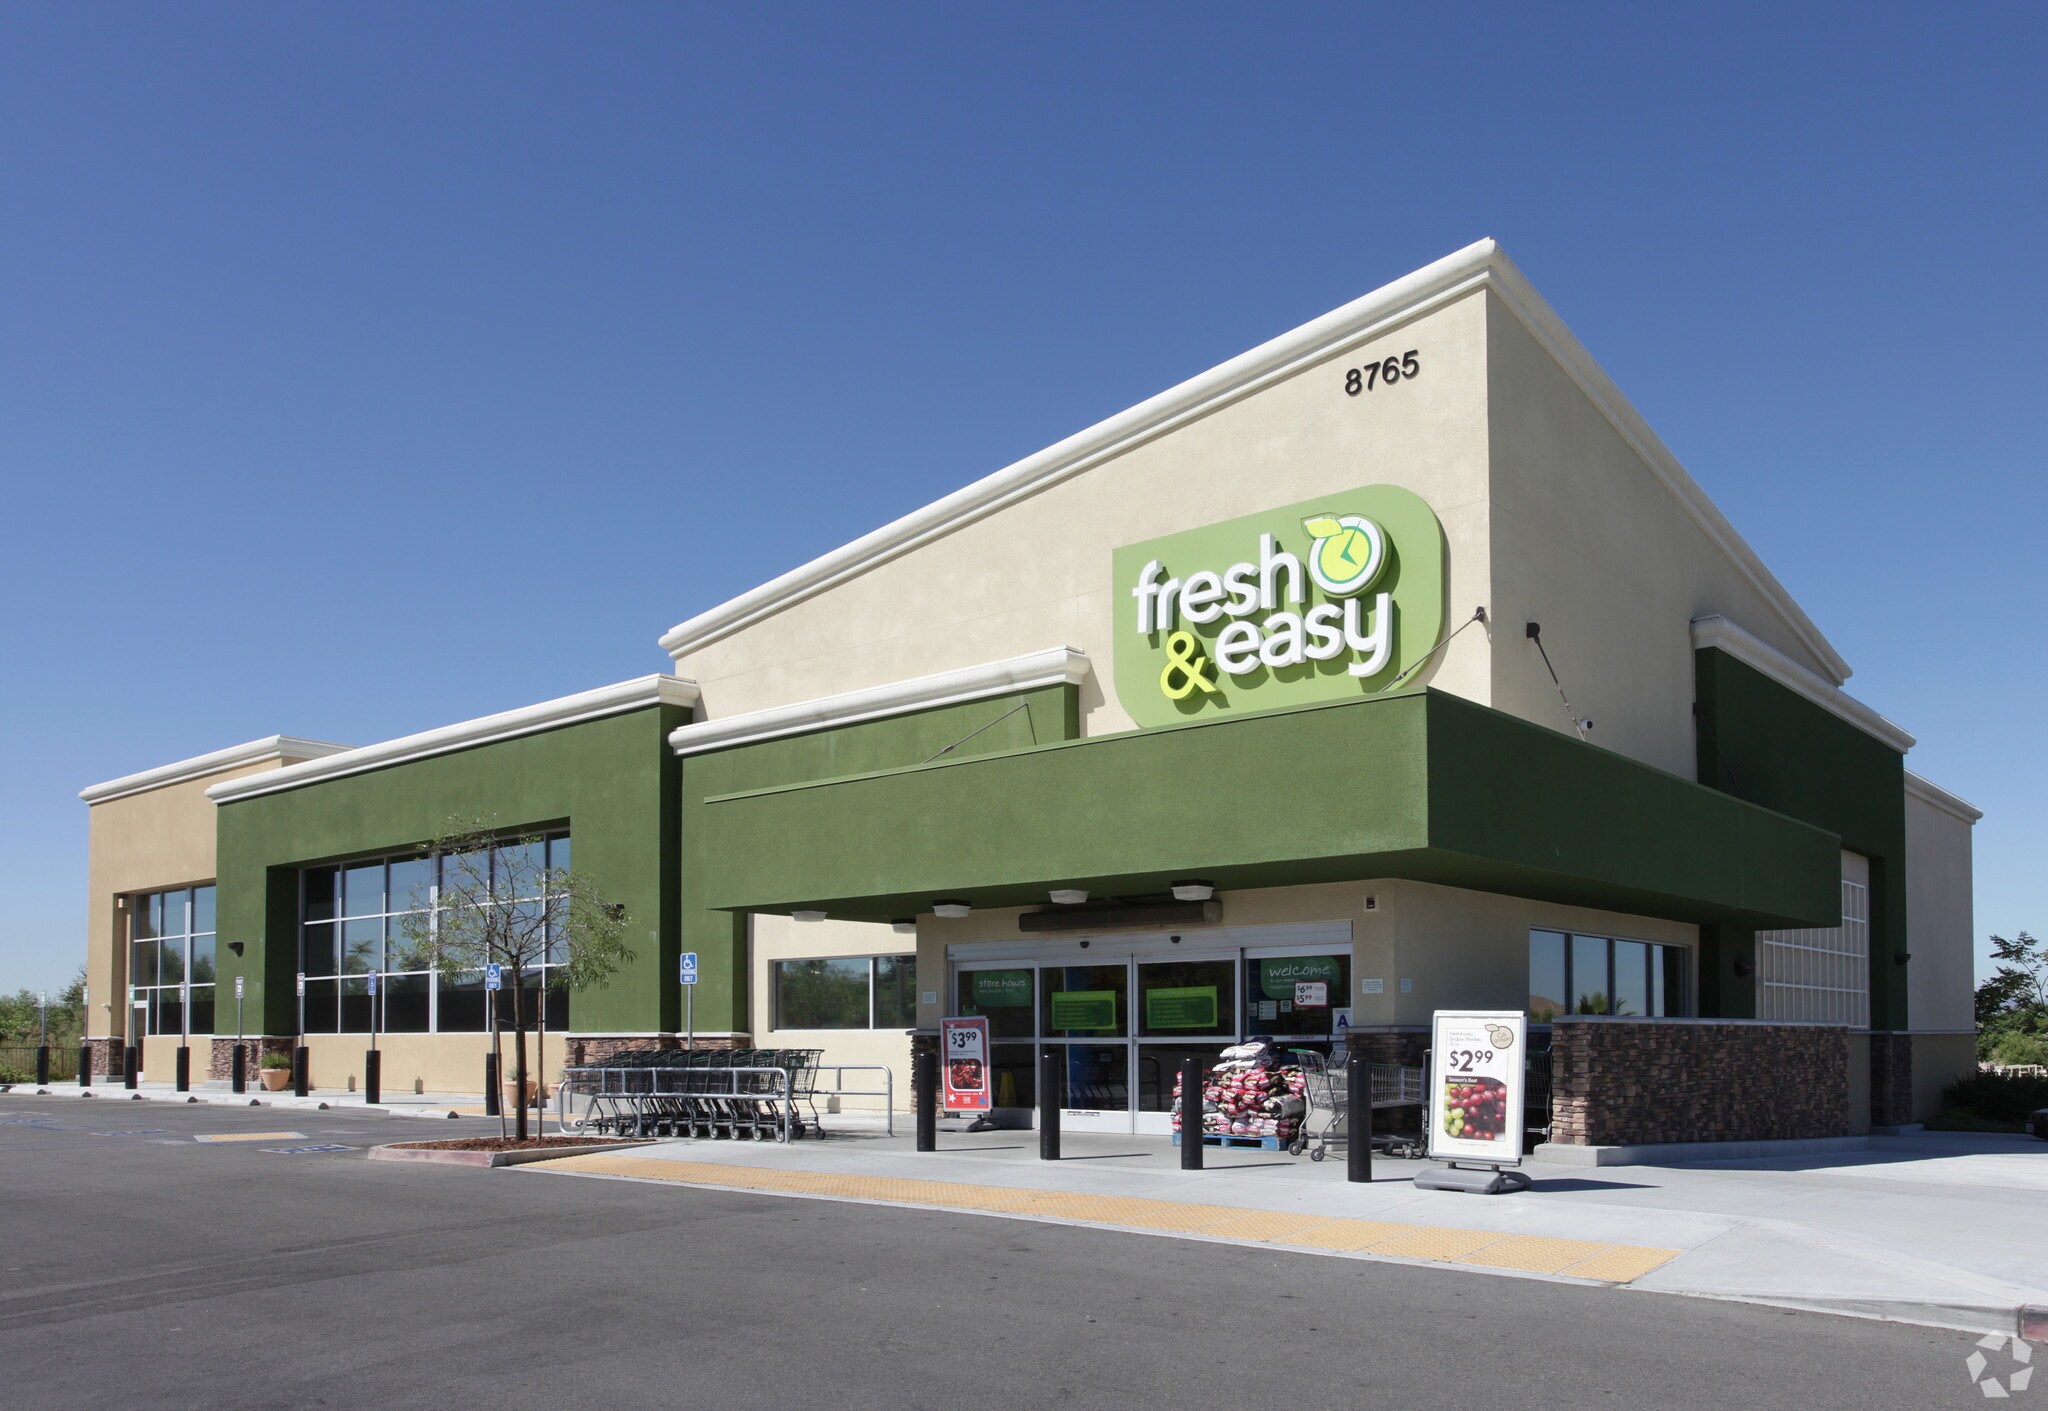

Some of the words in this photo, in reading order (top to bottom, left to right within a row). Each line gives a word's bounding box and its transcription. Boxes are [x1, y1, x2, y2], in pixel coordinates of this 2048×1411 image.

[1345, 349, 1420, 397] 8765
[1132, 532, 1305, 634] fresh
[1159, 630, 1218, 700] &
[1215, 592, 1392, 677] easy
[978, 978, 1000, 988] store
[1001, 978, 1026, 988] hours
[1269, 964, 1331, 977] welcome
[1337, 1014, 1349, 1027] A
